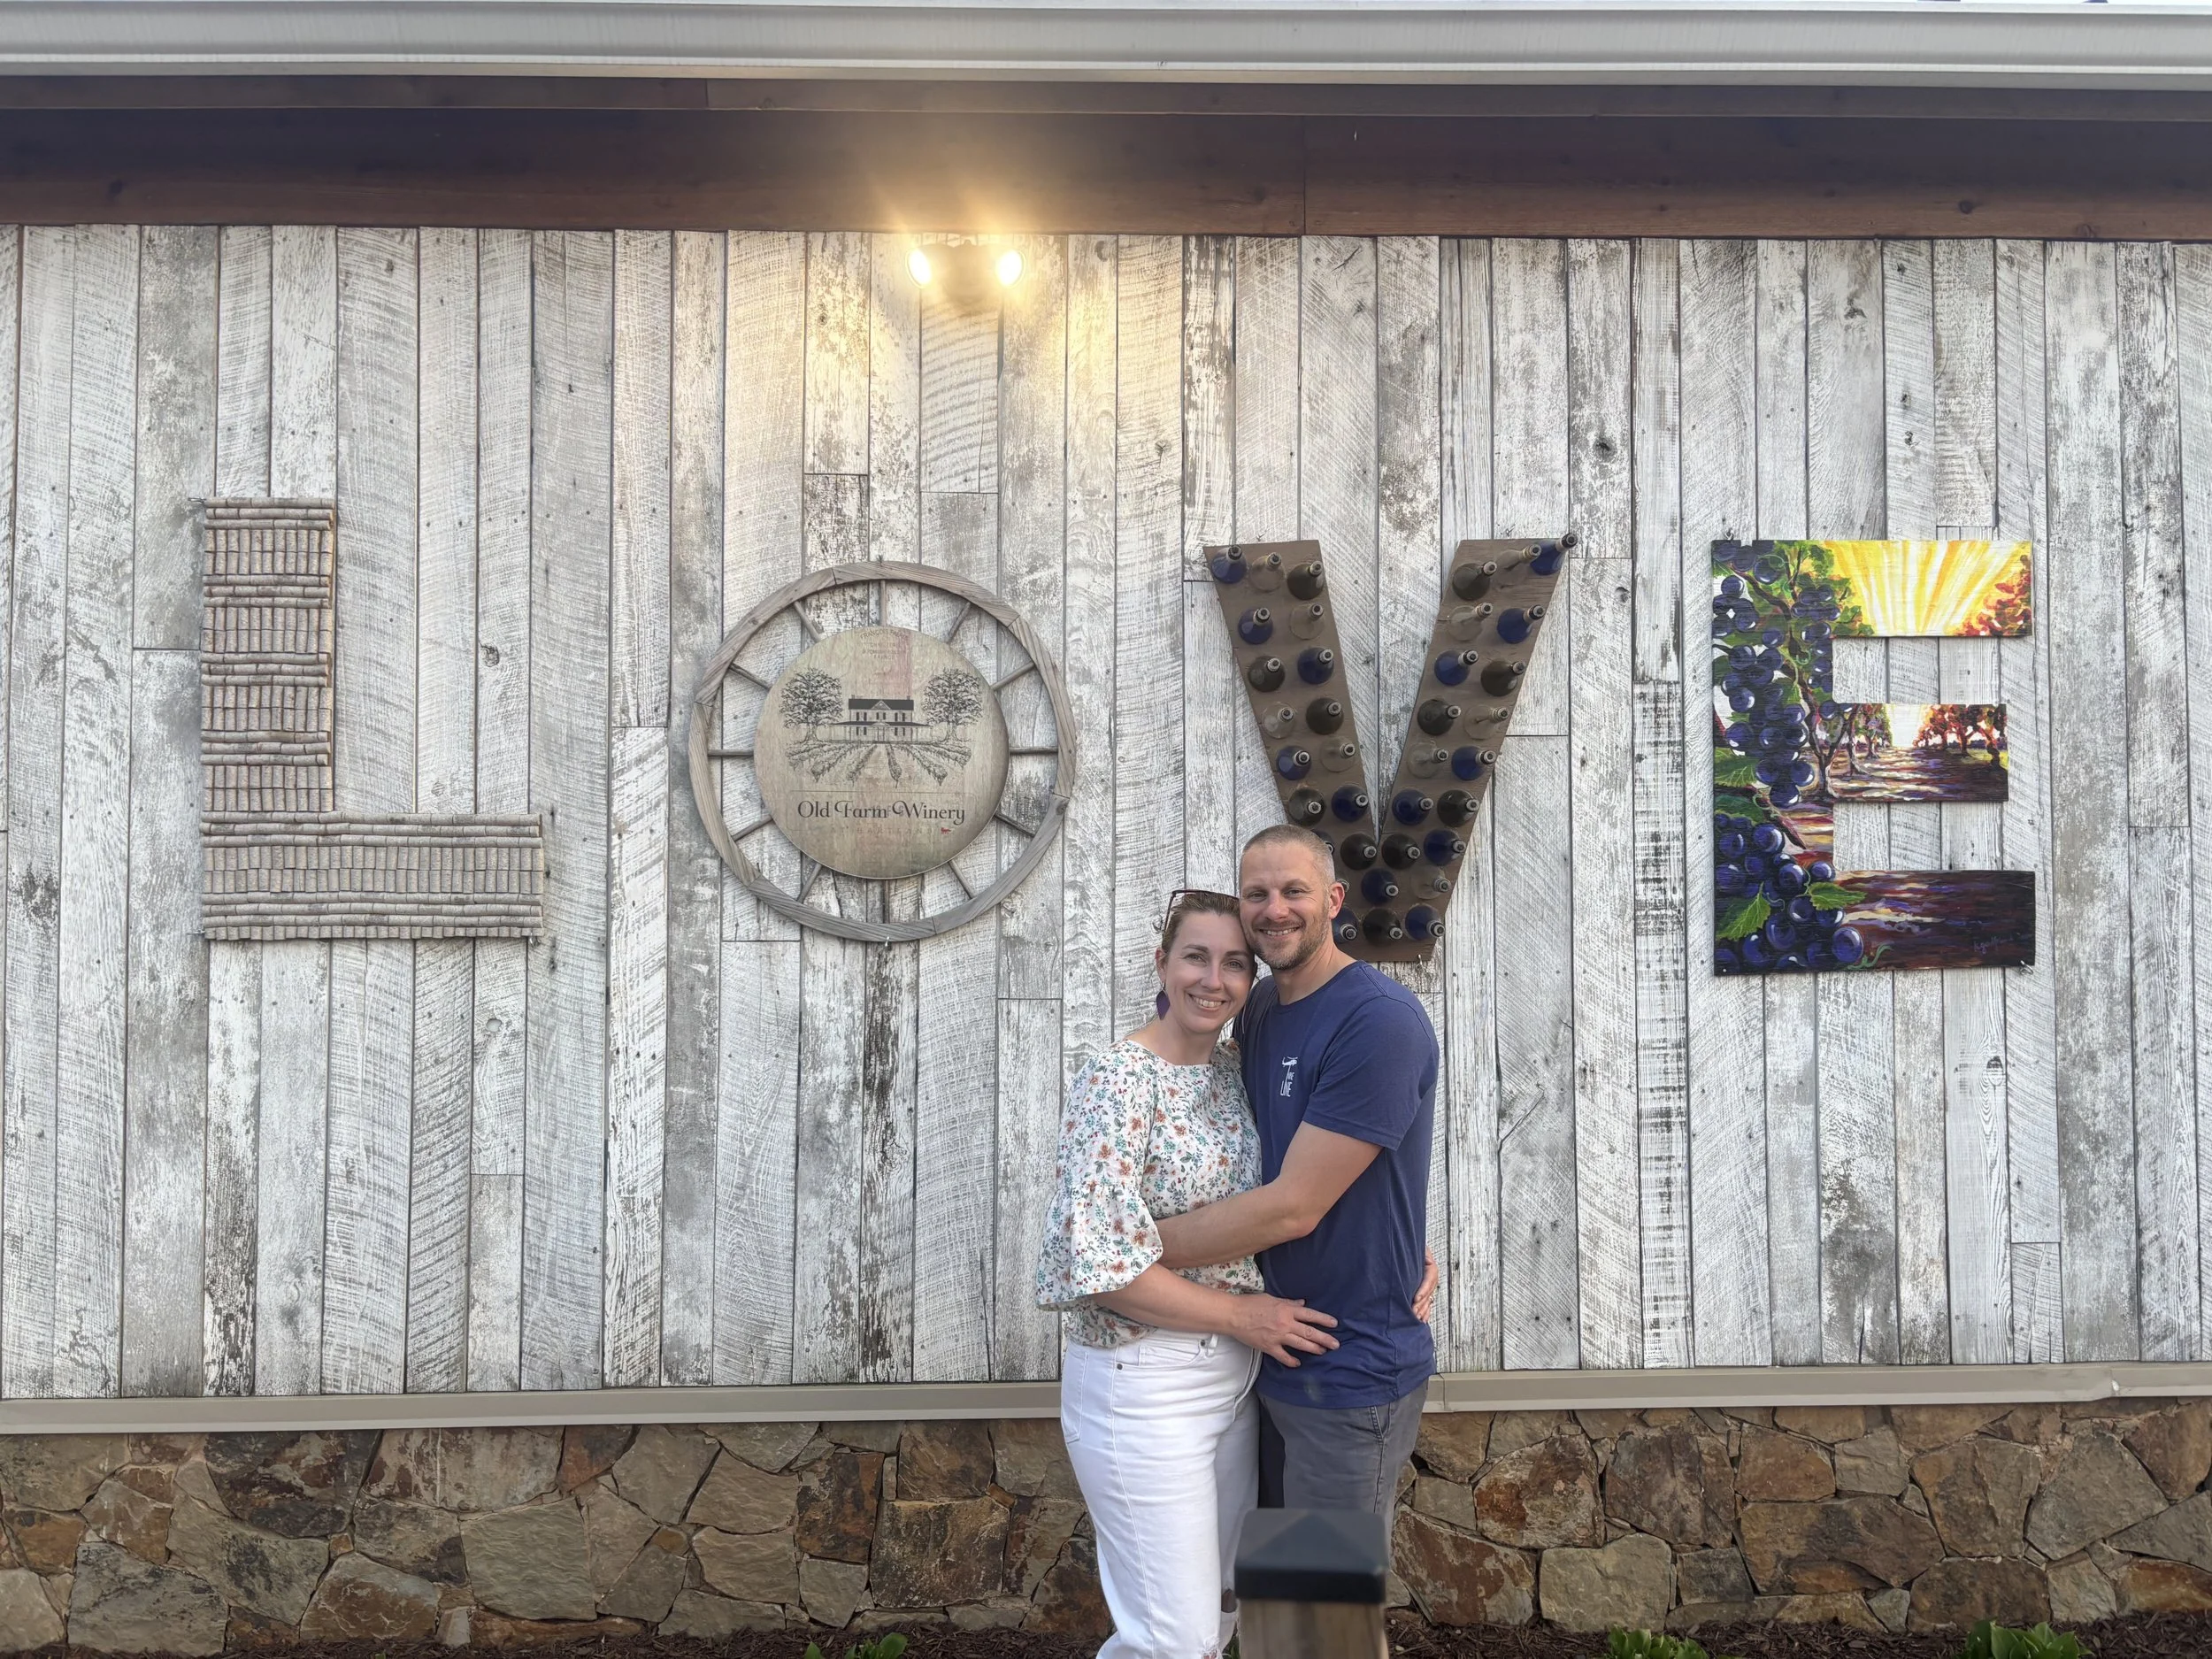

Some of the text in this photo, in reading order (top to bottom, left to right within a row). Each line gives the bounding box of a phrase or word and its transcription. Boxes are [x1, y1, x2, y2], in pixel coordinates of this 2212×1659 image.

[797, 800, 965, 826] Old Farm Winery
